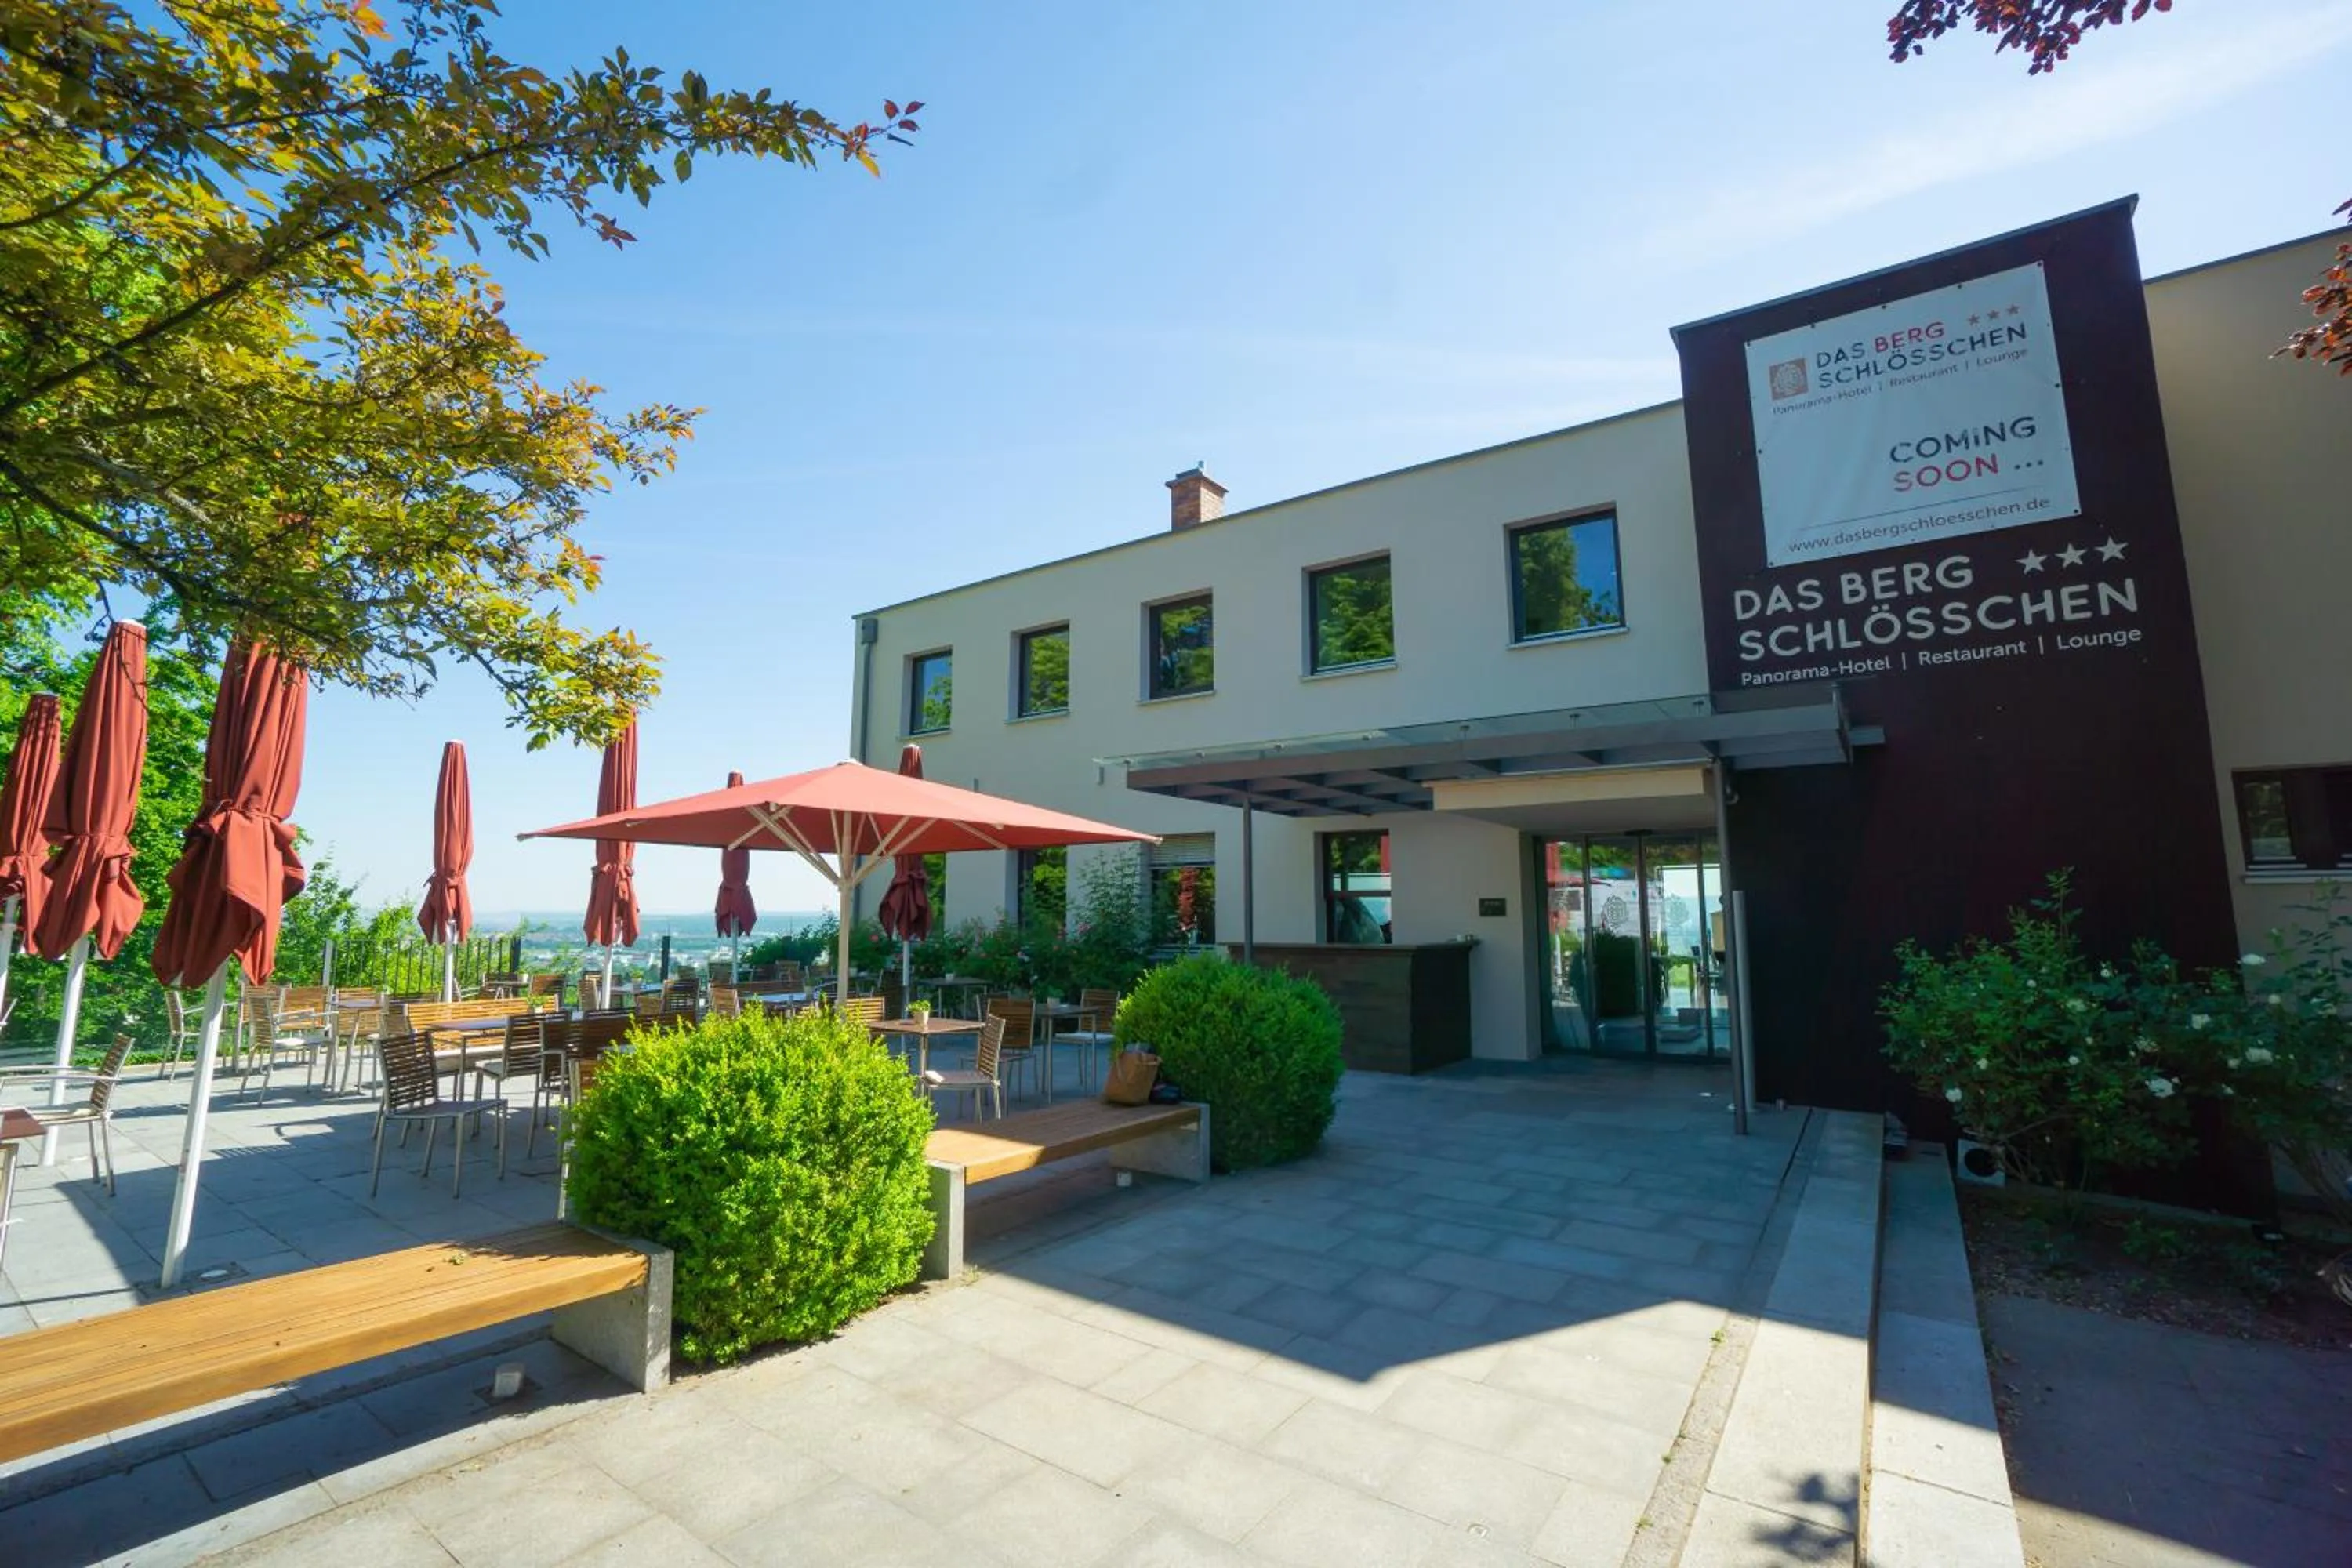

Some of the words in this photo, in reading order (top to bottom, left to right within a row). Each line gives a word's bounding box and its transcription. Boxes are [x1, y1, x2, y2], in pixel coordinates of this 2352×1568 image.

[1817, 342, 1865, 368] DAS
[1875, 321, 1945, 353] BERG
[1818, 322, 2027, 388] SCHLÖSSCHEN
[1889, 365, 1958, 387] Restaurant
[1976, 349, 2028, 367] Lounge
[1789, 496, 2051, 553] www.dasbergschloesschen.de
[1733, 579, 1824, 620] DAS
[1840, 555, 1974, 604] BERG
[1740, 578, 2138, 661] SCHLÖSSCHEN
[1741, 655, 1891, 686] Panorama-Hotel
[1918, 640, 2027, 666] Restaurant
[2057, 628, 2142, 650] Lounge
